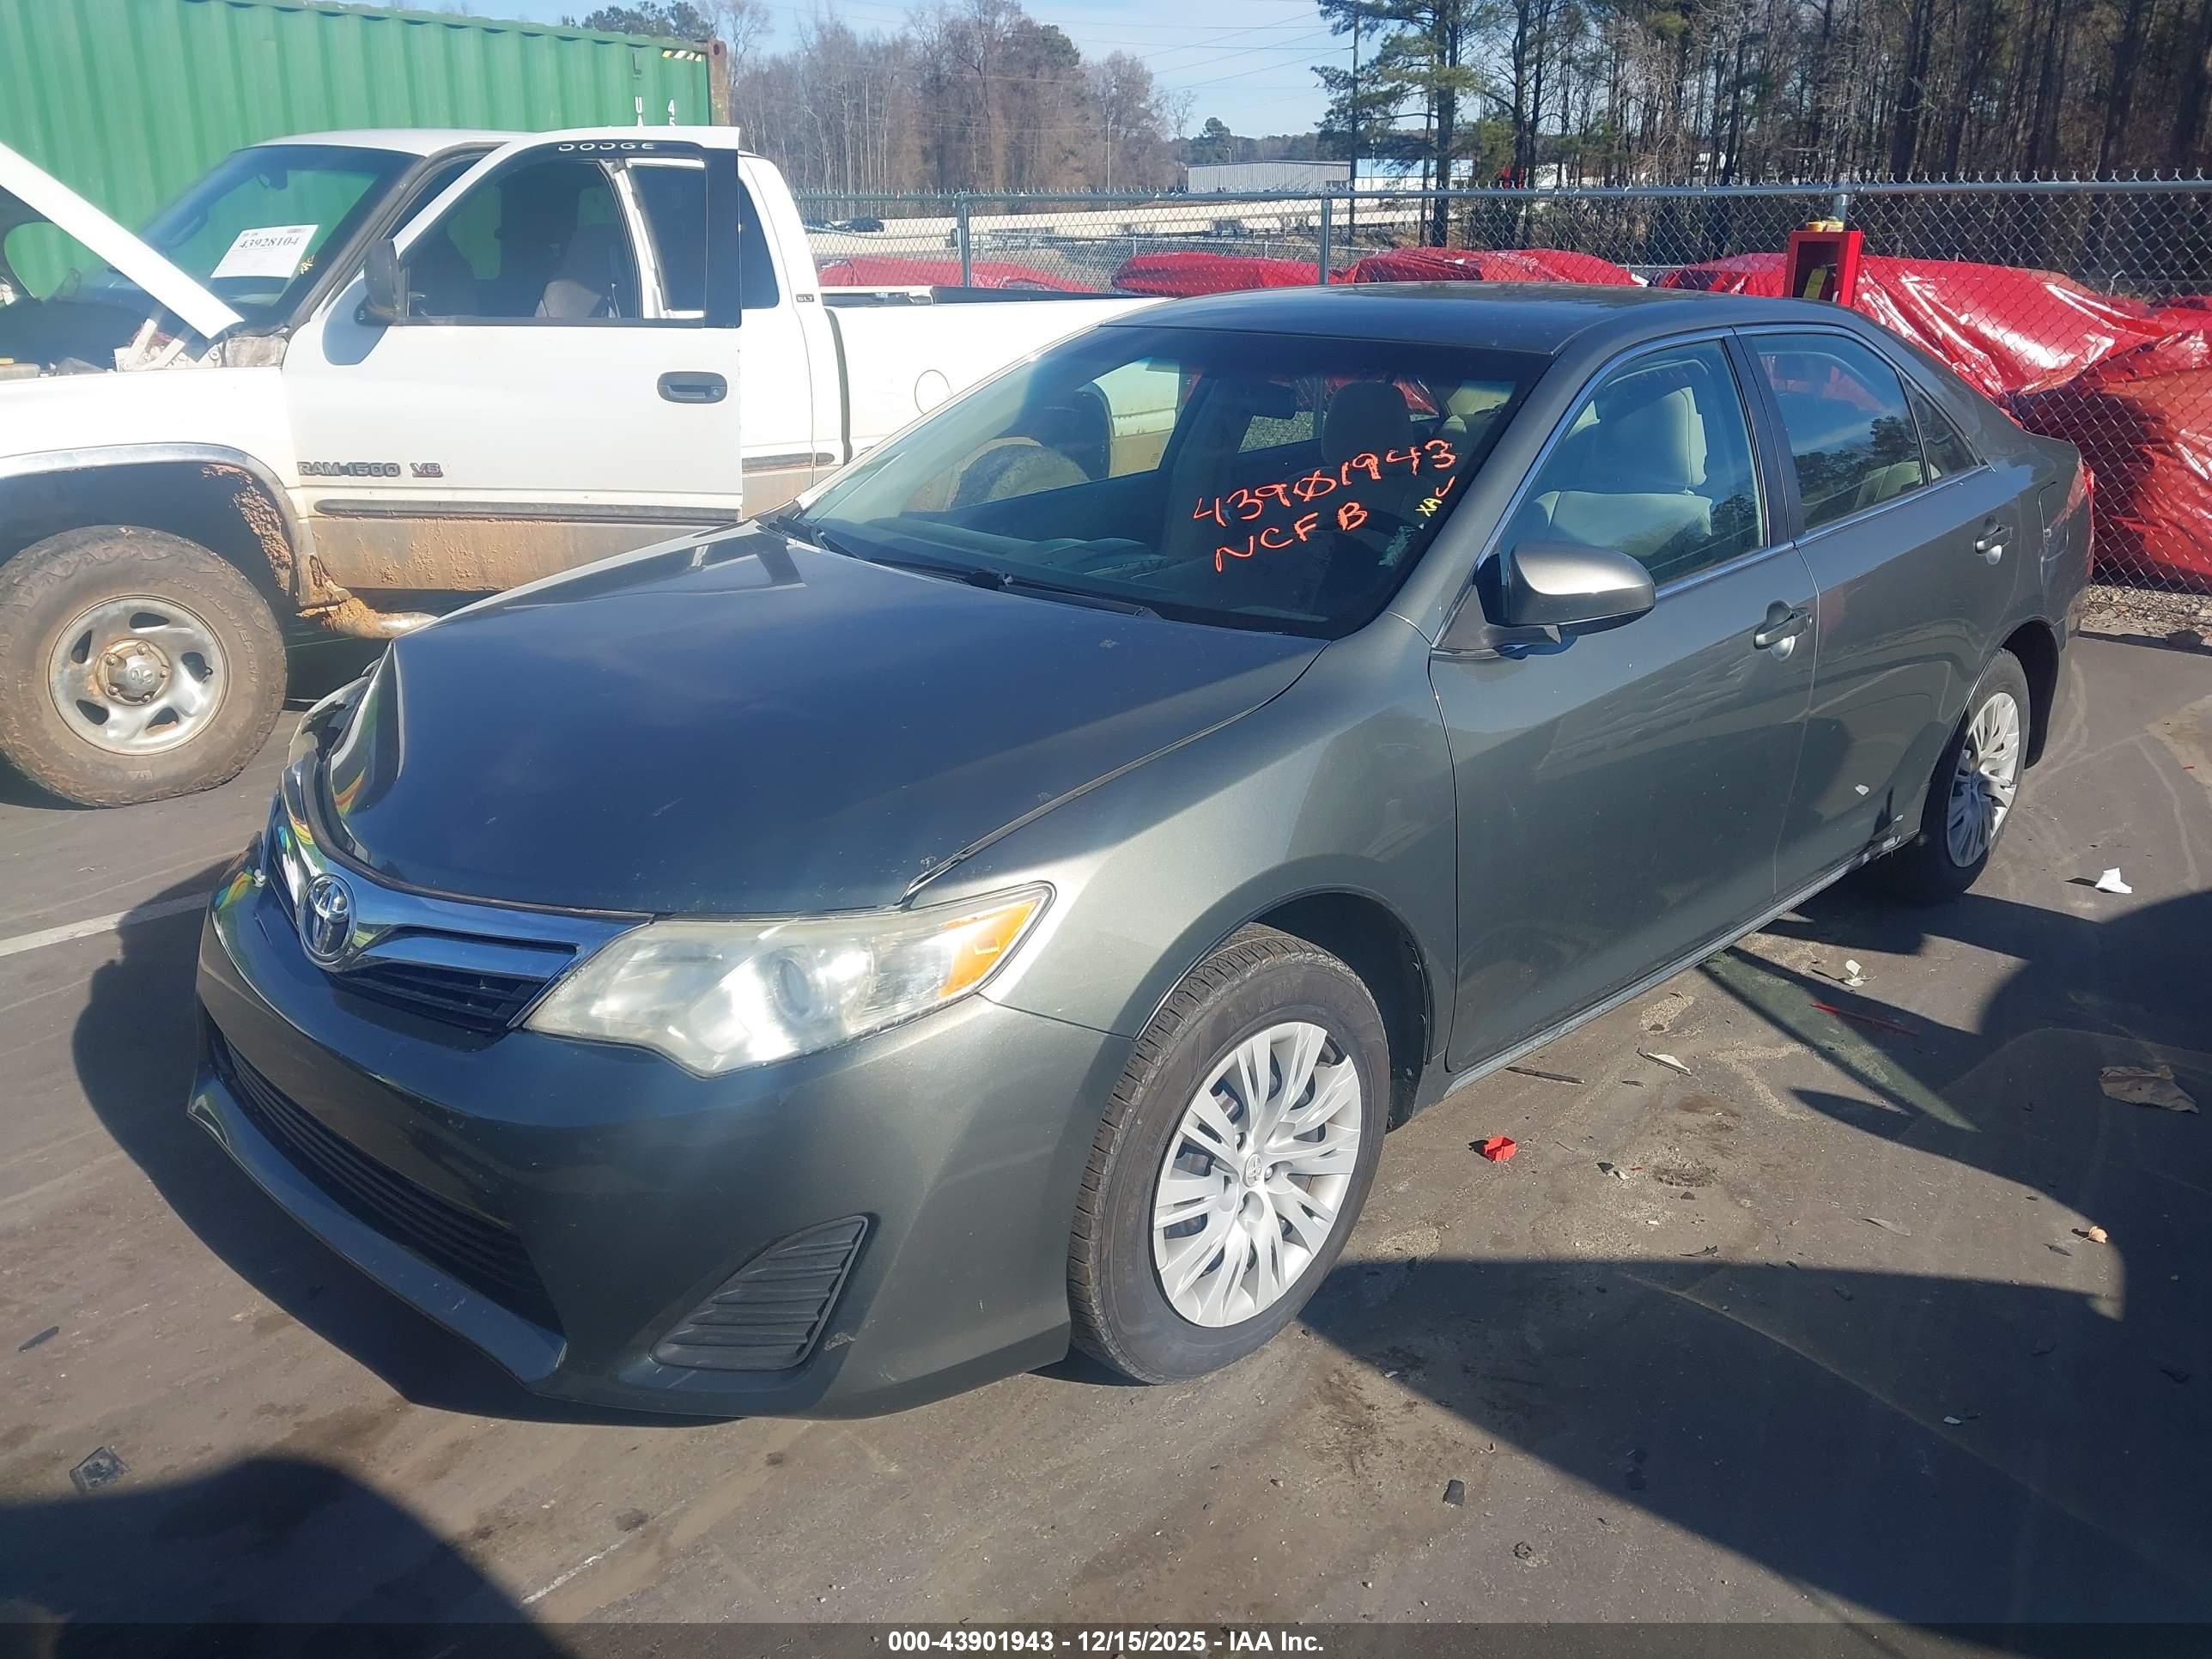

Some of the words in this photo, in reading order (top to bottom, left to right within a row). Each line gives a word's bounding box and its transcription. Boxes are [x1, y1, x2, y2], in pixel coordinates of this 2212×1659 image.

[558, 142, 654, 151] DODGE
[297, 461, 341, 477] RAM
[344, 462, 401, 477] 1500
